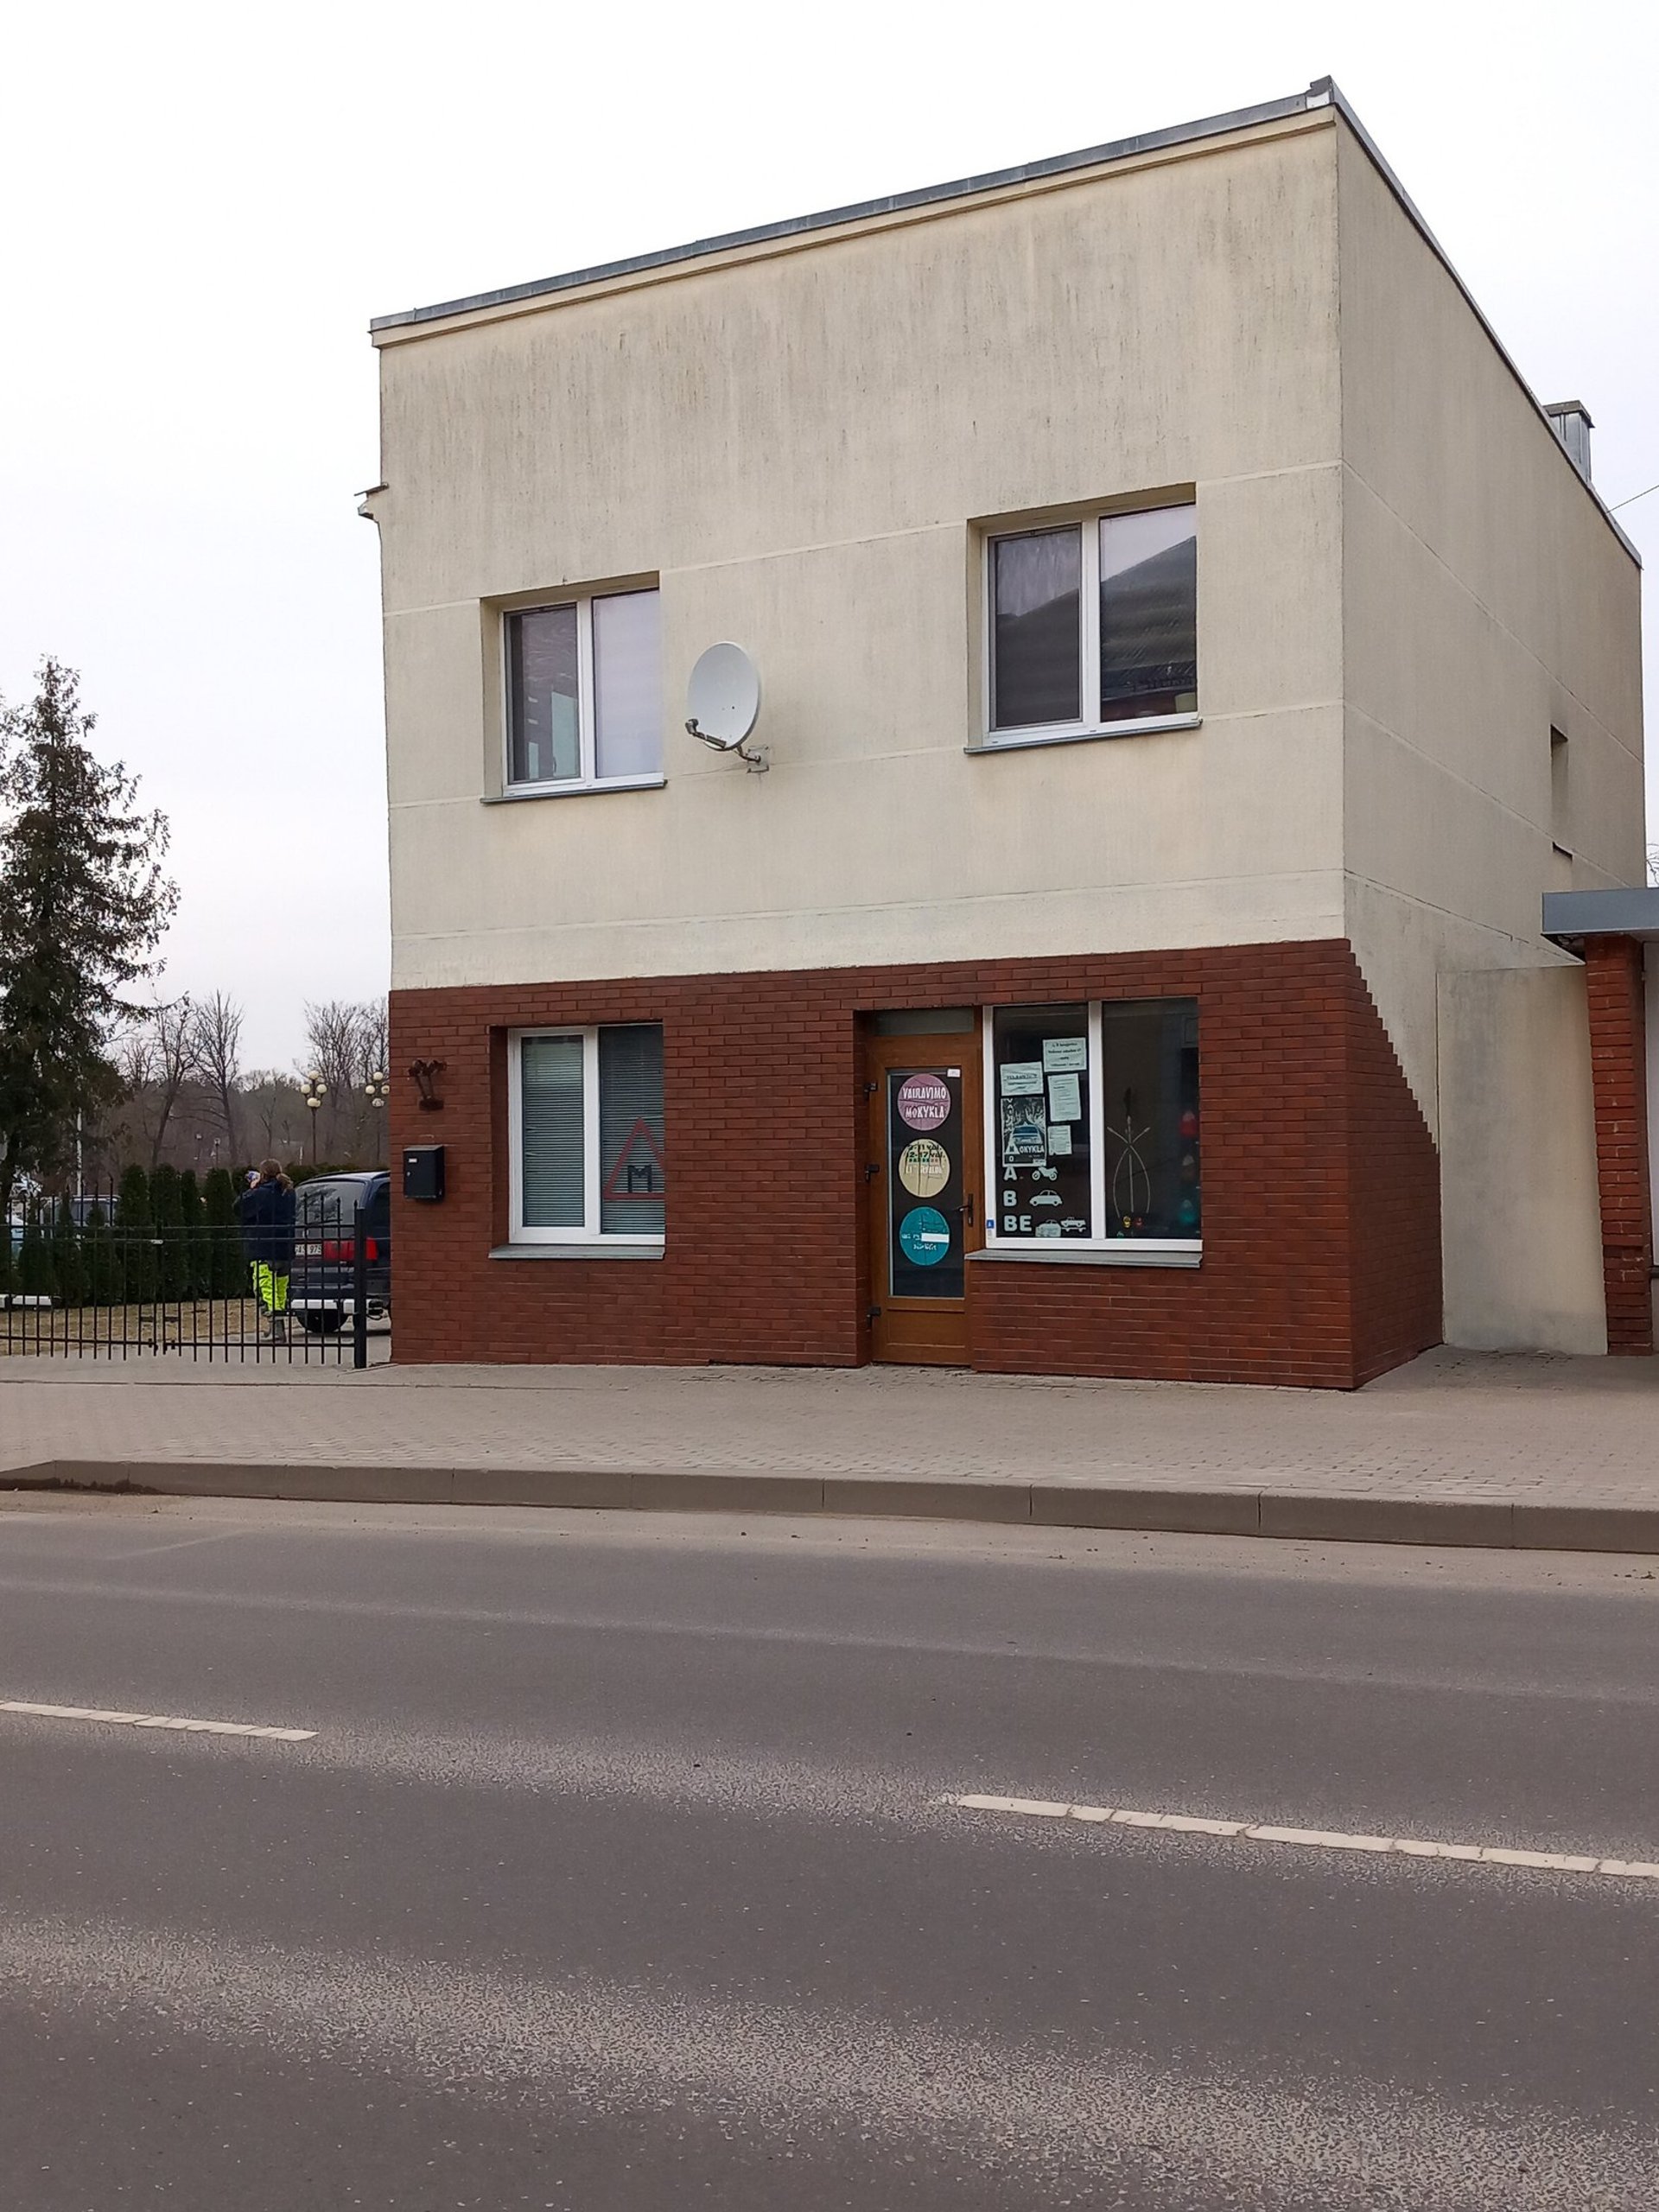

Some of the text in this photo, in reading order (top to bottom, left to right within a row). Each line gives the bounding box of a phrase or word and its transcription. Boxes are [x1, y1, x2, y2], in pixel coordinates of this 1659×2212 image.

[902, 1086, 946, 1099] VAIRAVIMO
[905, 1105, 944, 1118] MOKYKLA
[1003, 1166, 1018, 1180] A
[1003, 1190, 1018, 1206] B
[1003, 1215, 1033, 1231] BE
